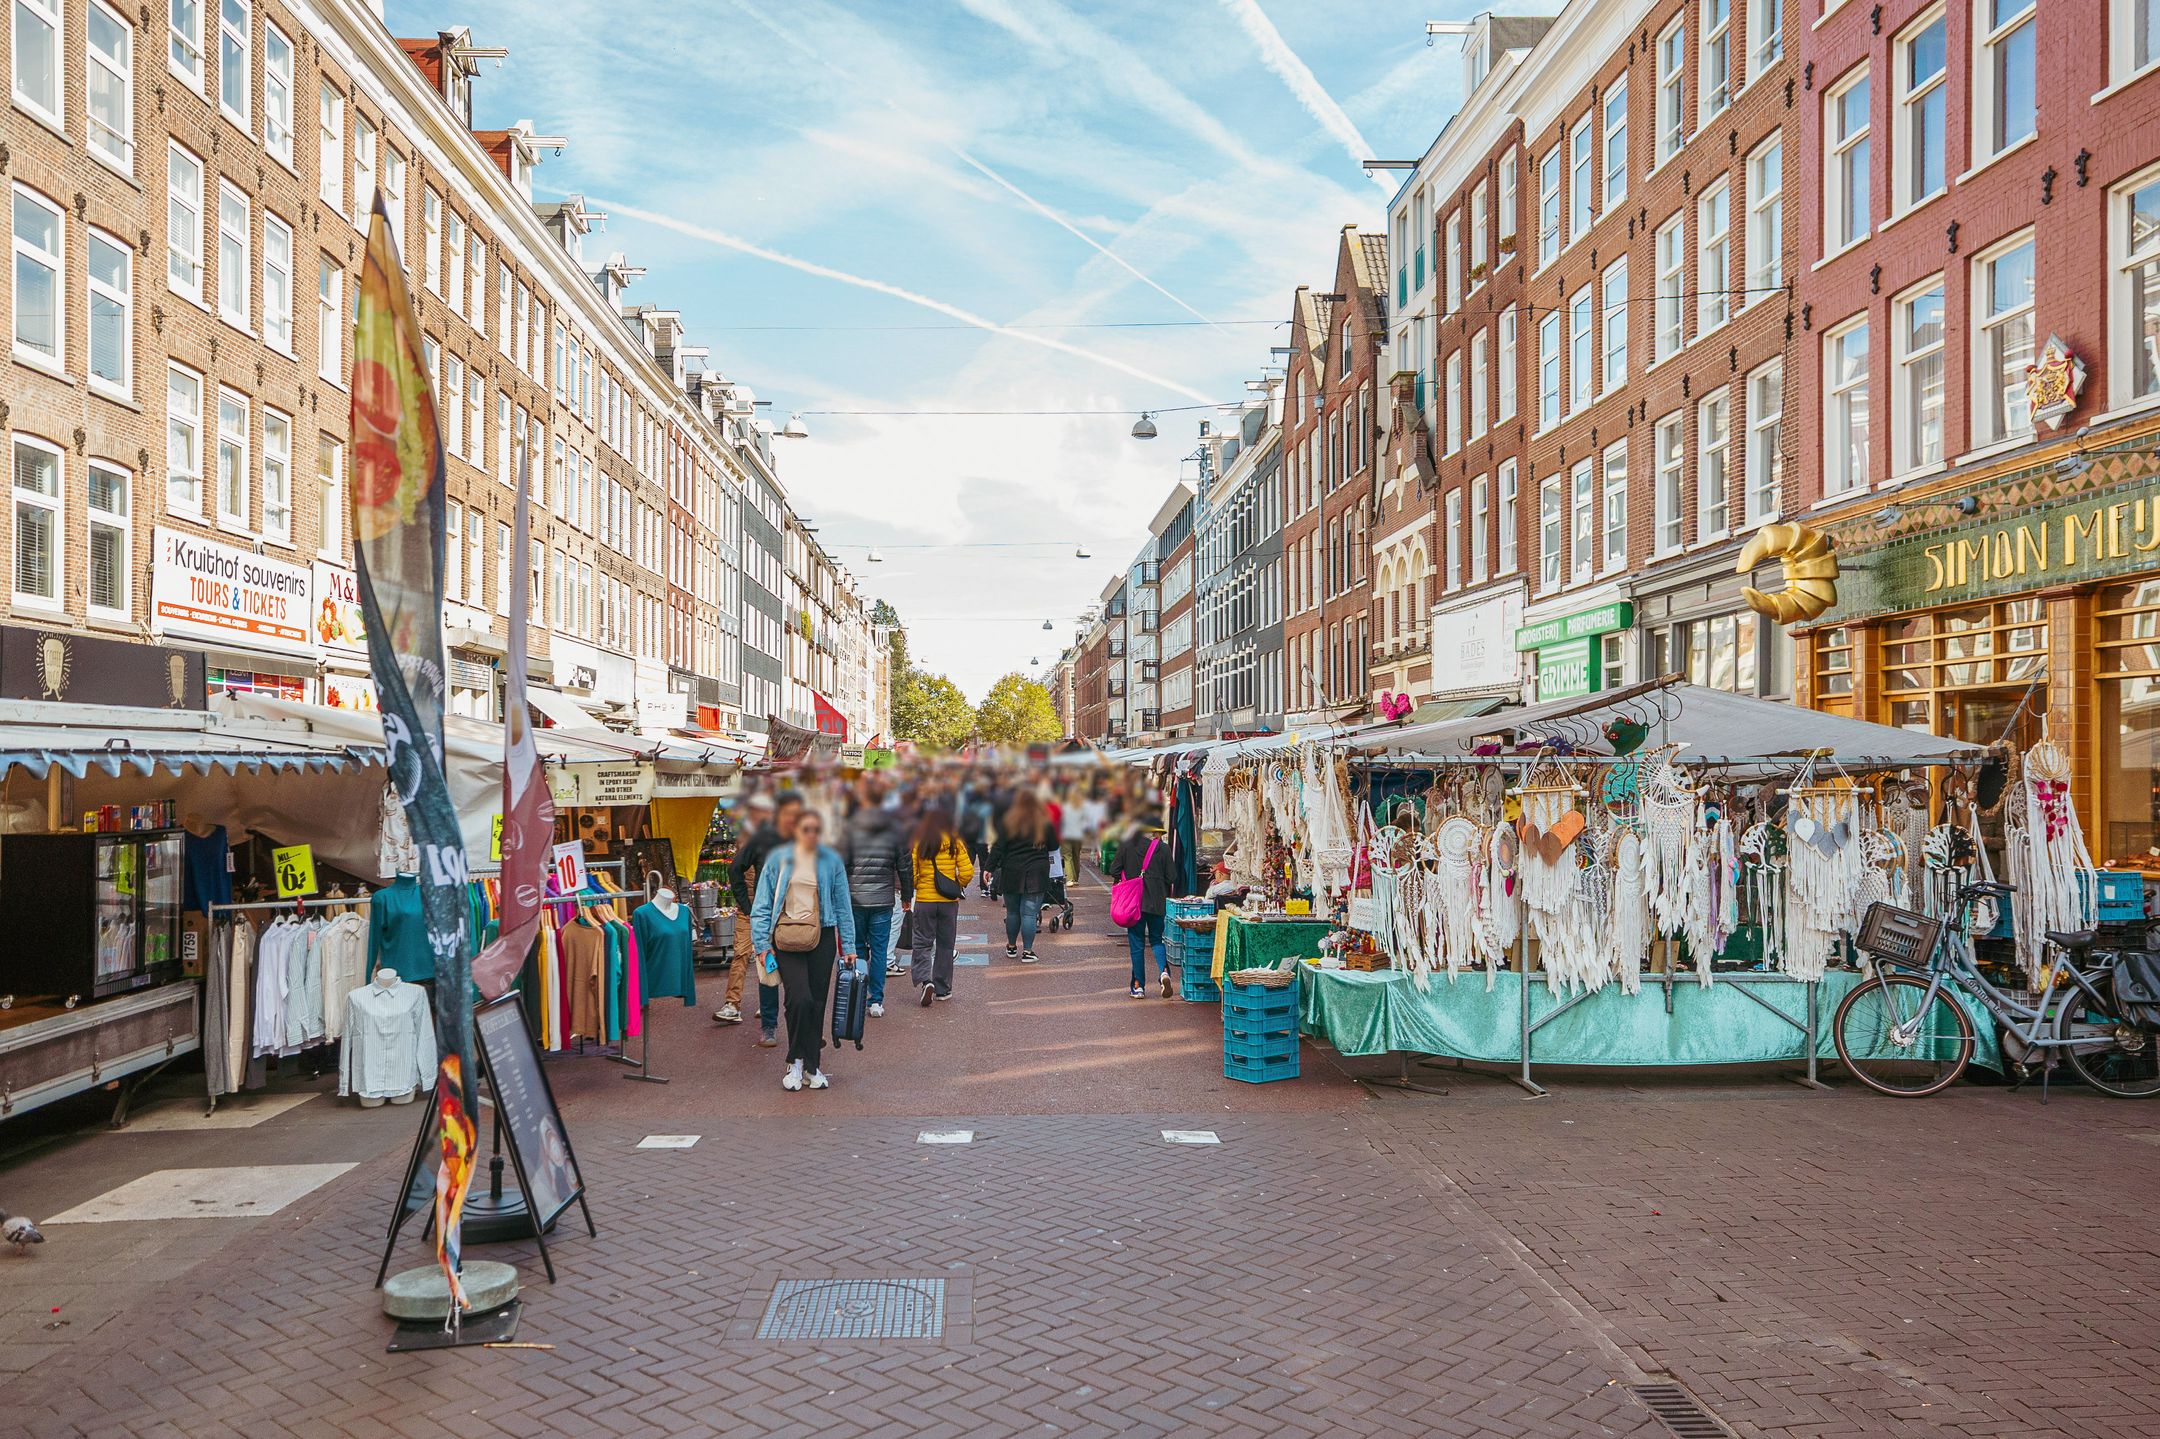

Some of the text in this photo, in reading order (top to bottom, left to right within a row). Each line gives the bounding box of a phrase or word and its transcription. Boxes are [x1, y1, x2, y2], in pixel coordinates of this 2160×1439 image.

[175, 538, 306, 597] Kruithof souvenirs
[1924, 521, 2048, 593] SIMON
[190, 576, 229, 609] TOURS
[232, 587, 240, 611] &
[243, 588, 287, 620] TICKETS
[1567, 608, 1615, 634] PARFUMERIE
[1540, 660, 1588, 696] GRIMME
[597, 770, 641, 778] CRAFTSMANSHIP
[618, 793, 643, 801] ELEMENTS
[184, 933, 196, 959] 1759
